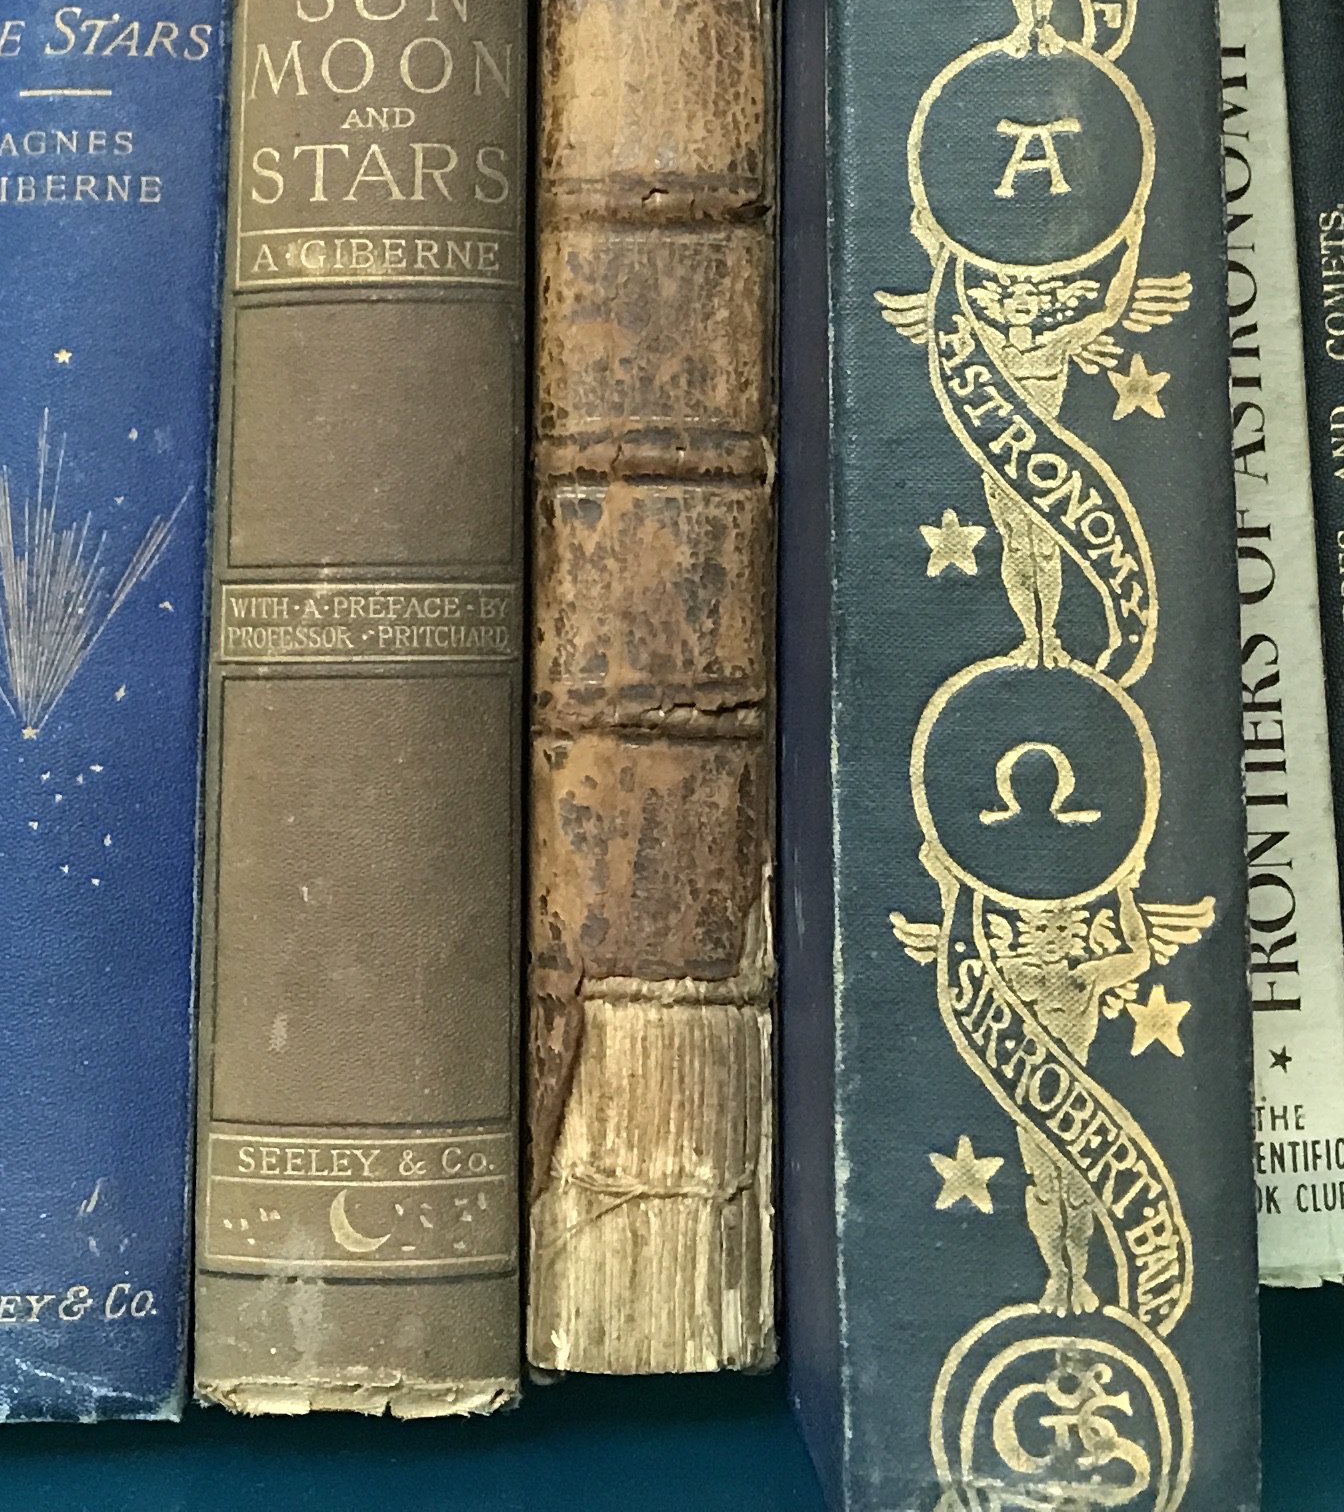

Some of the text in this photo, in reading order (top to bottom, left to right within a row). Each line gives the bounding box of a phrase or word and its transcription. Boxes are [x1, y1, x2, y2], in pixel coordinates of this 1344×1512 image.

[44, 5, 215, 62] STARS
[249, 36, 515, 101] MOON
[341, 107, 417, 131] AND
[250, 143, 511, 206] STARS
[300, 238, 502, 273] GIBERNE
[1236, 507, 1278, 606] OF
[229, 596, 290, 620] WITH
[332, 595, 462, 620] PREFACE
[479, 596, 509, 619] BY
[226, 624, 509, 650] PROFESSOR PRITCHARD
[1241, 632, 1302, 1013] FRONTIERS
[950, 957, 1012, 1069] SIR
[1001, 1023, 1163, 1221] ROBERT
[1253, 1104, 1306, 1132] THE
[237, 1145, 380, 1178] SEELEY
[398, 1149, 428, 1176] &
[58, 1283, 94, 1322] &
